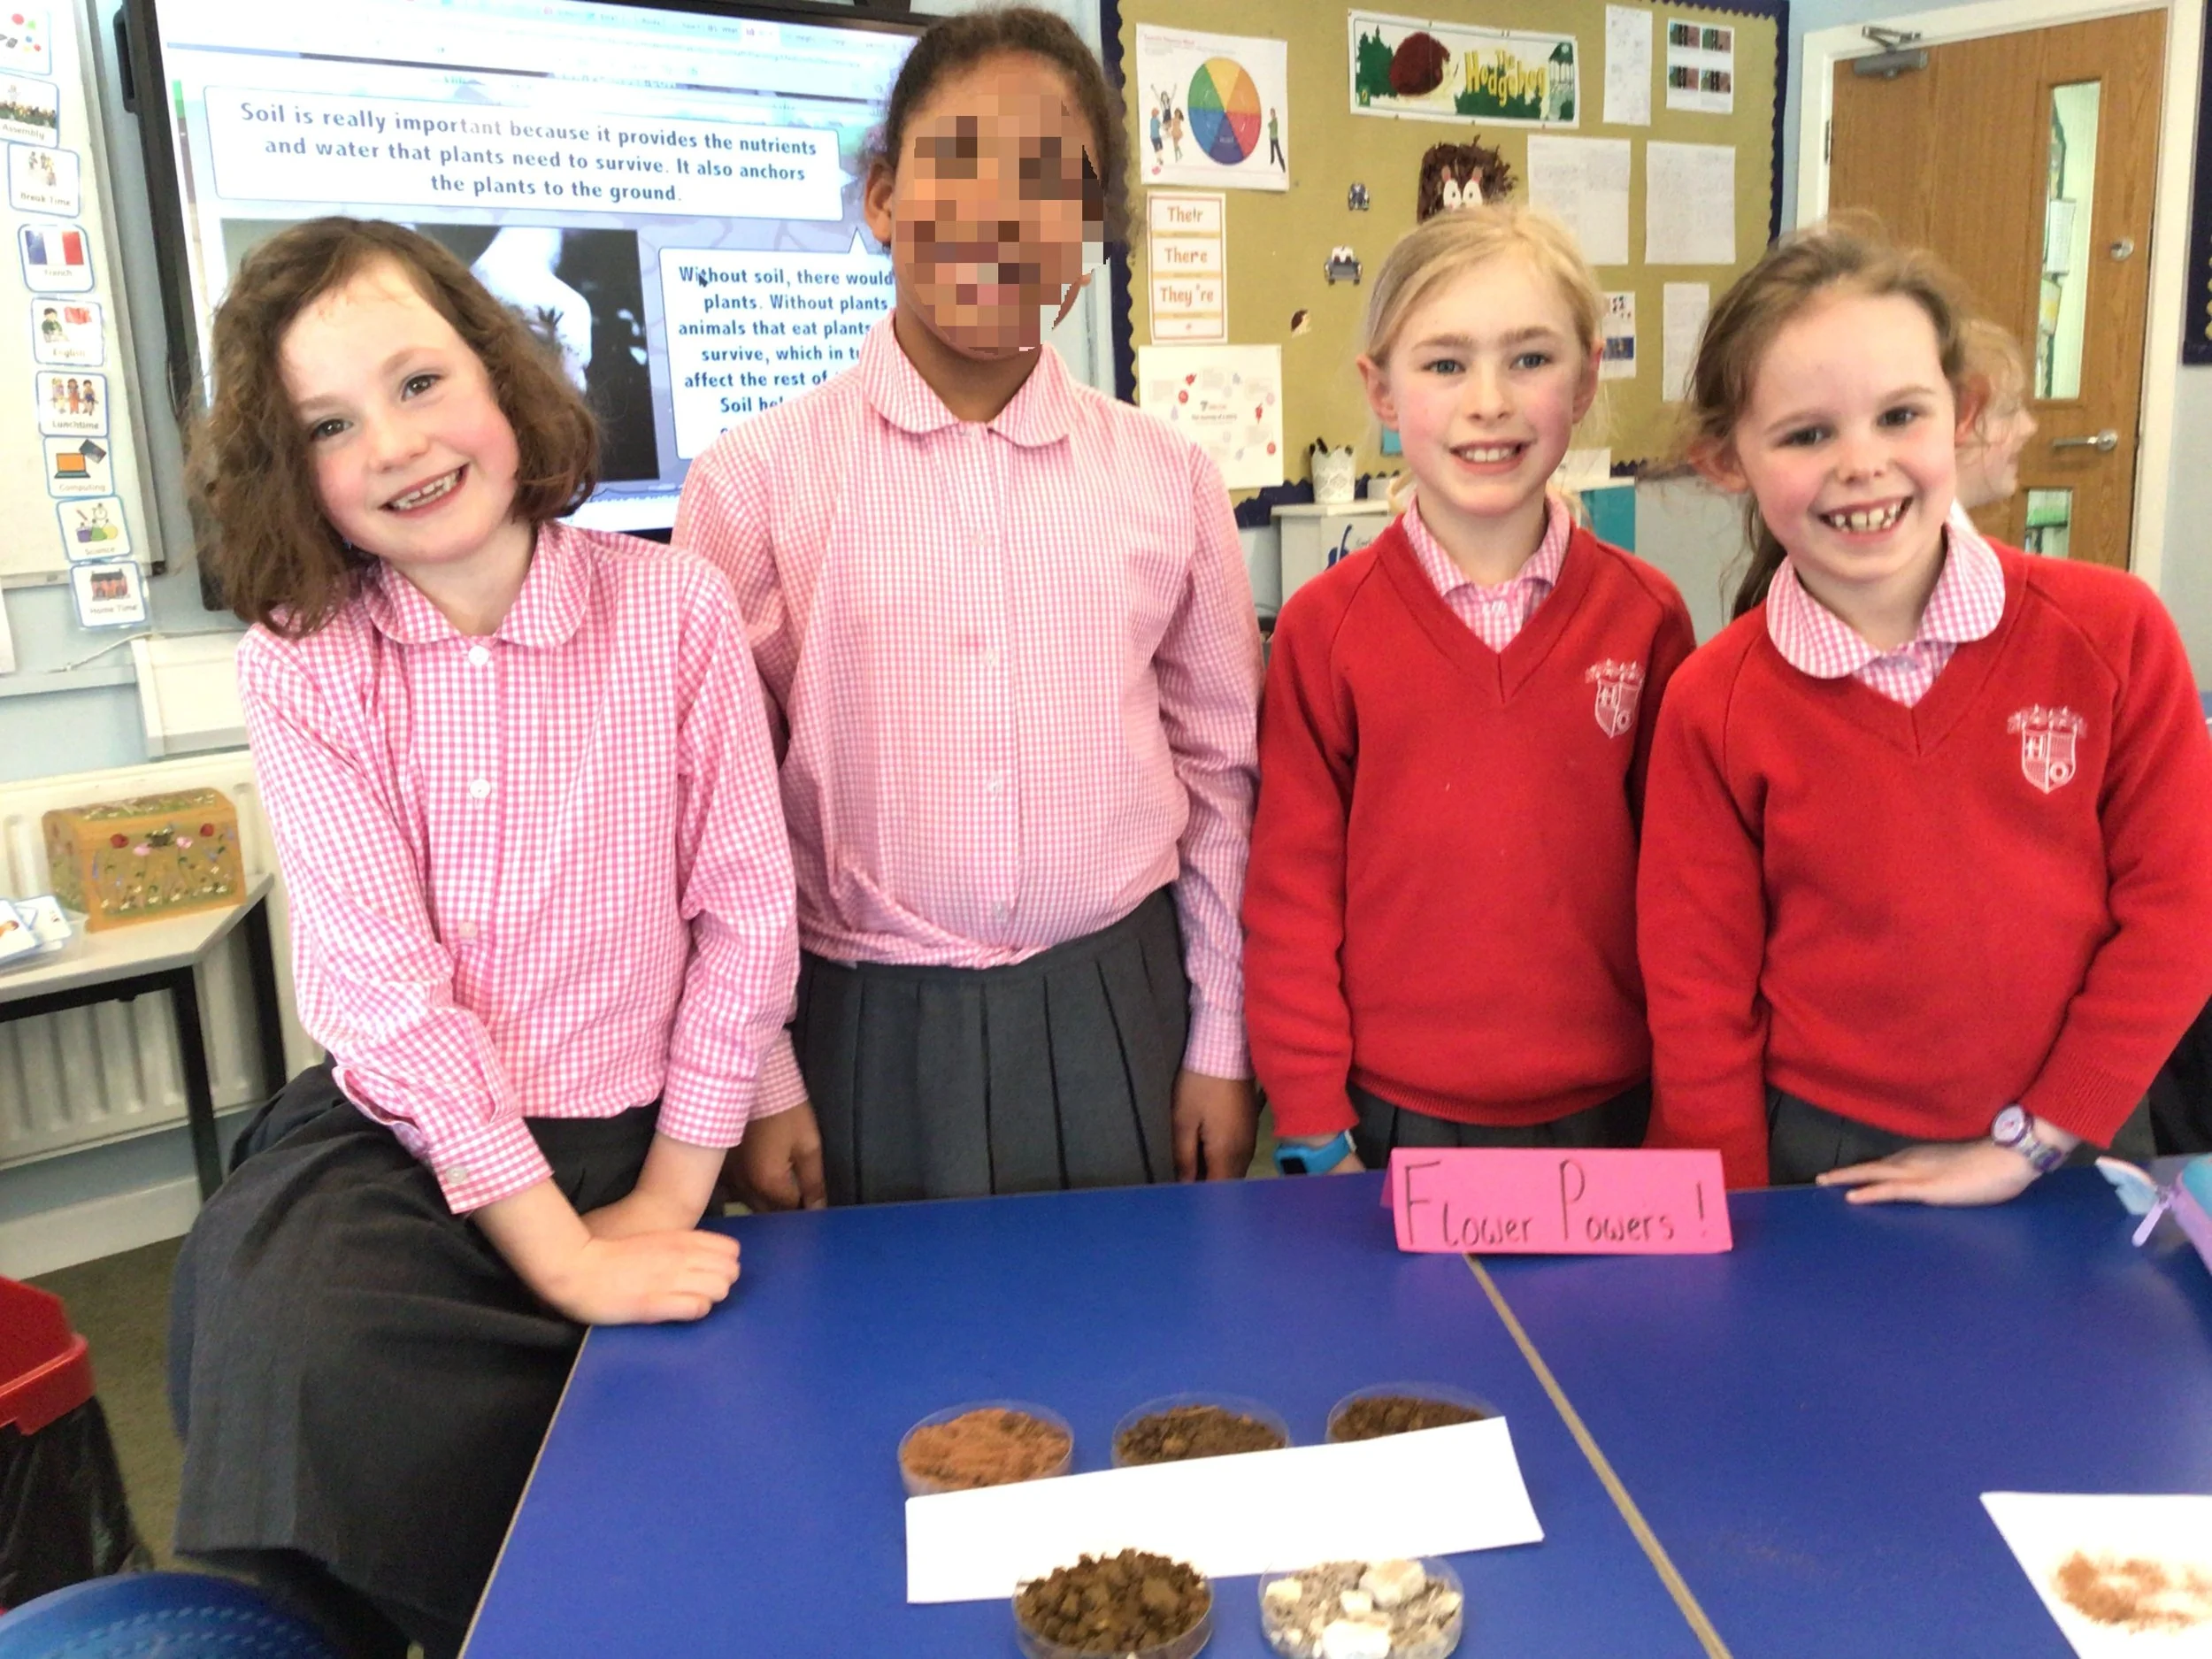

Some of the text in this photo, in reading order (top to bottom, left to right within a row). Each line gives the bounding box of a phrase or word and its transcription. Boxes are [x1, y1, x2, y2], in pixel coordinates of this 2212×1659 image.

[2, 124, 45, 141] Assembly
[240, 102, 817, 155] Soil is really important because it provides the nutrients
[265, 137, 805, 180] and water that plants need to survive. It also anchors
[431, 174, 681, 204] the plants to the ground.
[1167, 205, 1203, 222] Their
[1164, 247, 1208, 264] There
[679, 266, 893, 288] Without soil, there would
[703, 294, 887, 314] plants. Without plants
[679, 319, 746, 335] animals
[752, 319, 786, 335] that
[793, 321, 818, 335] eat
[702, 347, 770, 365] survive,
[776, 345, 822, 360] which
[829, 345, 842, 360] in
[684, 372, 733, 388] affect
[741, 372, 767, 387] the
[773, 373, 805, 387] rest
[720, 396, 752, 413] Soil
[52, 419, 99, 431] Lunchtime
[1404, 1160, 1533, 1247] Flower
